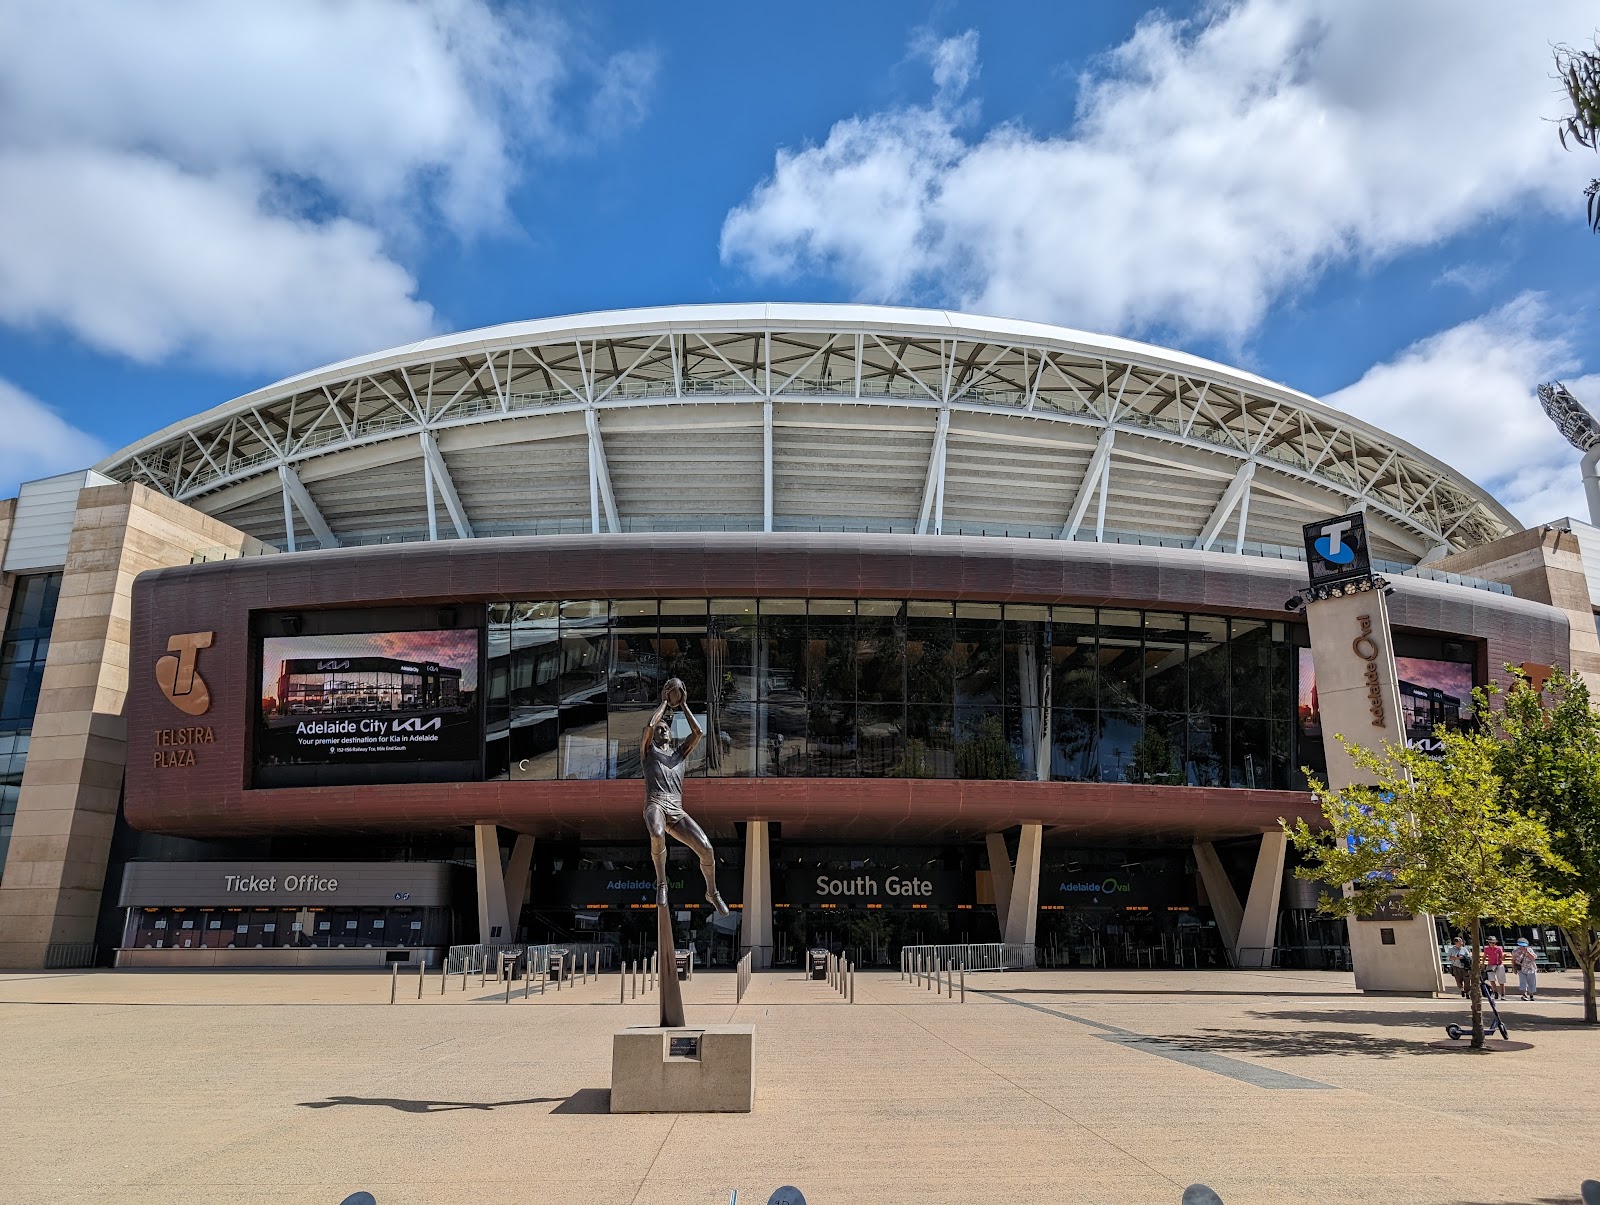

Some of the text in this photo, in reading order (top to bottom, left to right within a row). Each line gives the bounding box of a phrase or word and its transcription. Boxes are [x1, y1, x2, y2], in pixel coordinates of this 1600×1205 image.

[1352, 614, 1386, 728] Adelaide Oval
[296, 717, 442, 735] Adelaide City KIA
[154, 726, 215, 747] TELSTRA
[298, 733, 439, 746] Your premier destination for Kia in Adelaide
[153, 749, 196, 769] PLAZA
[224, 875, 338, 892] Ticket Office
[606, 880, 651, 891] Adelaide
[815, 875, 933, 897] South Gate
[1059, 877, 1131, 894] Adelaide Oval
